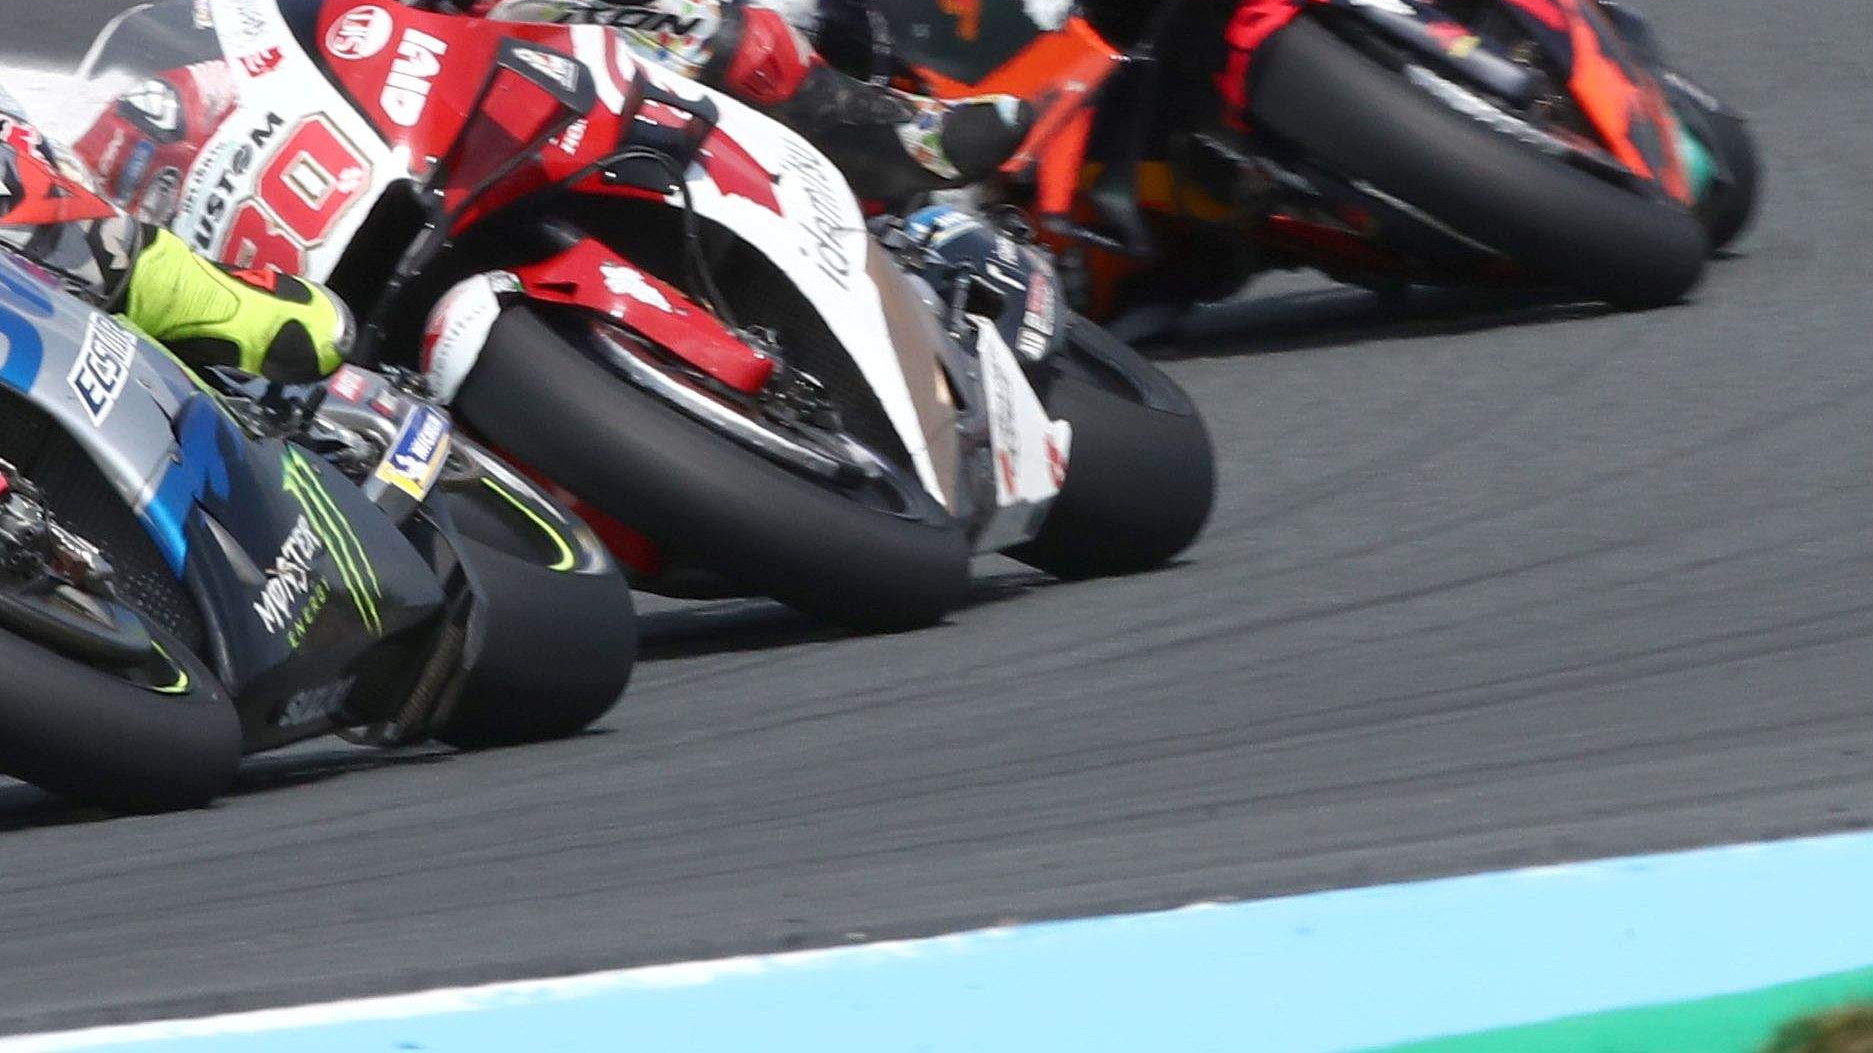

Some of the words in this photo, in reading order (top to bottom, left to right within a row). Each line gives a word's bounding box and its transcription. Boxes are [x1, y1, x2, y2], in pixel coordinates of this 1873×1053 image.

[378, 27, 449, 127] GIVI
[192, 110, 286, 250] USTOM
[253, 513, 322, 634] MONSTER
